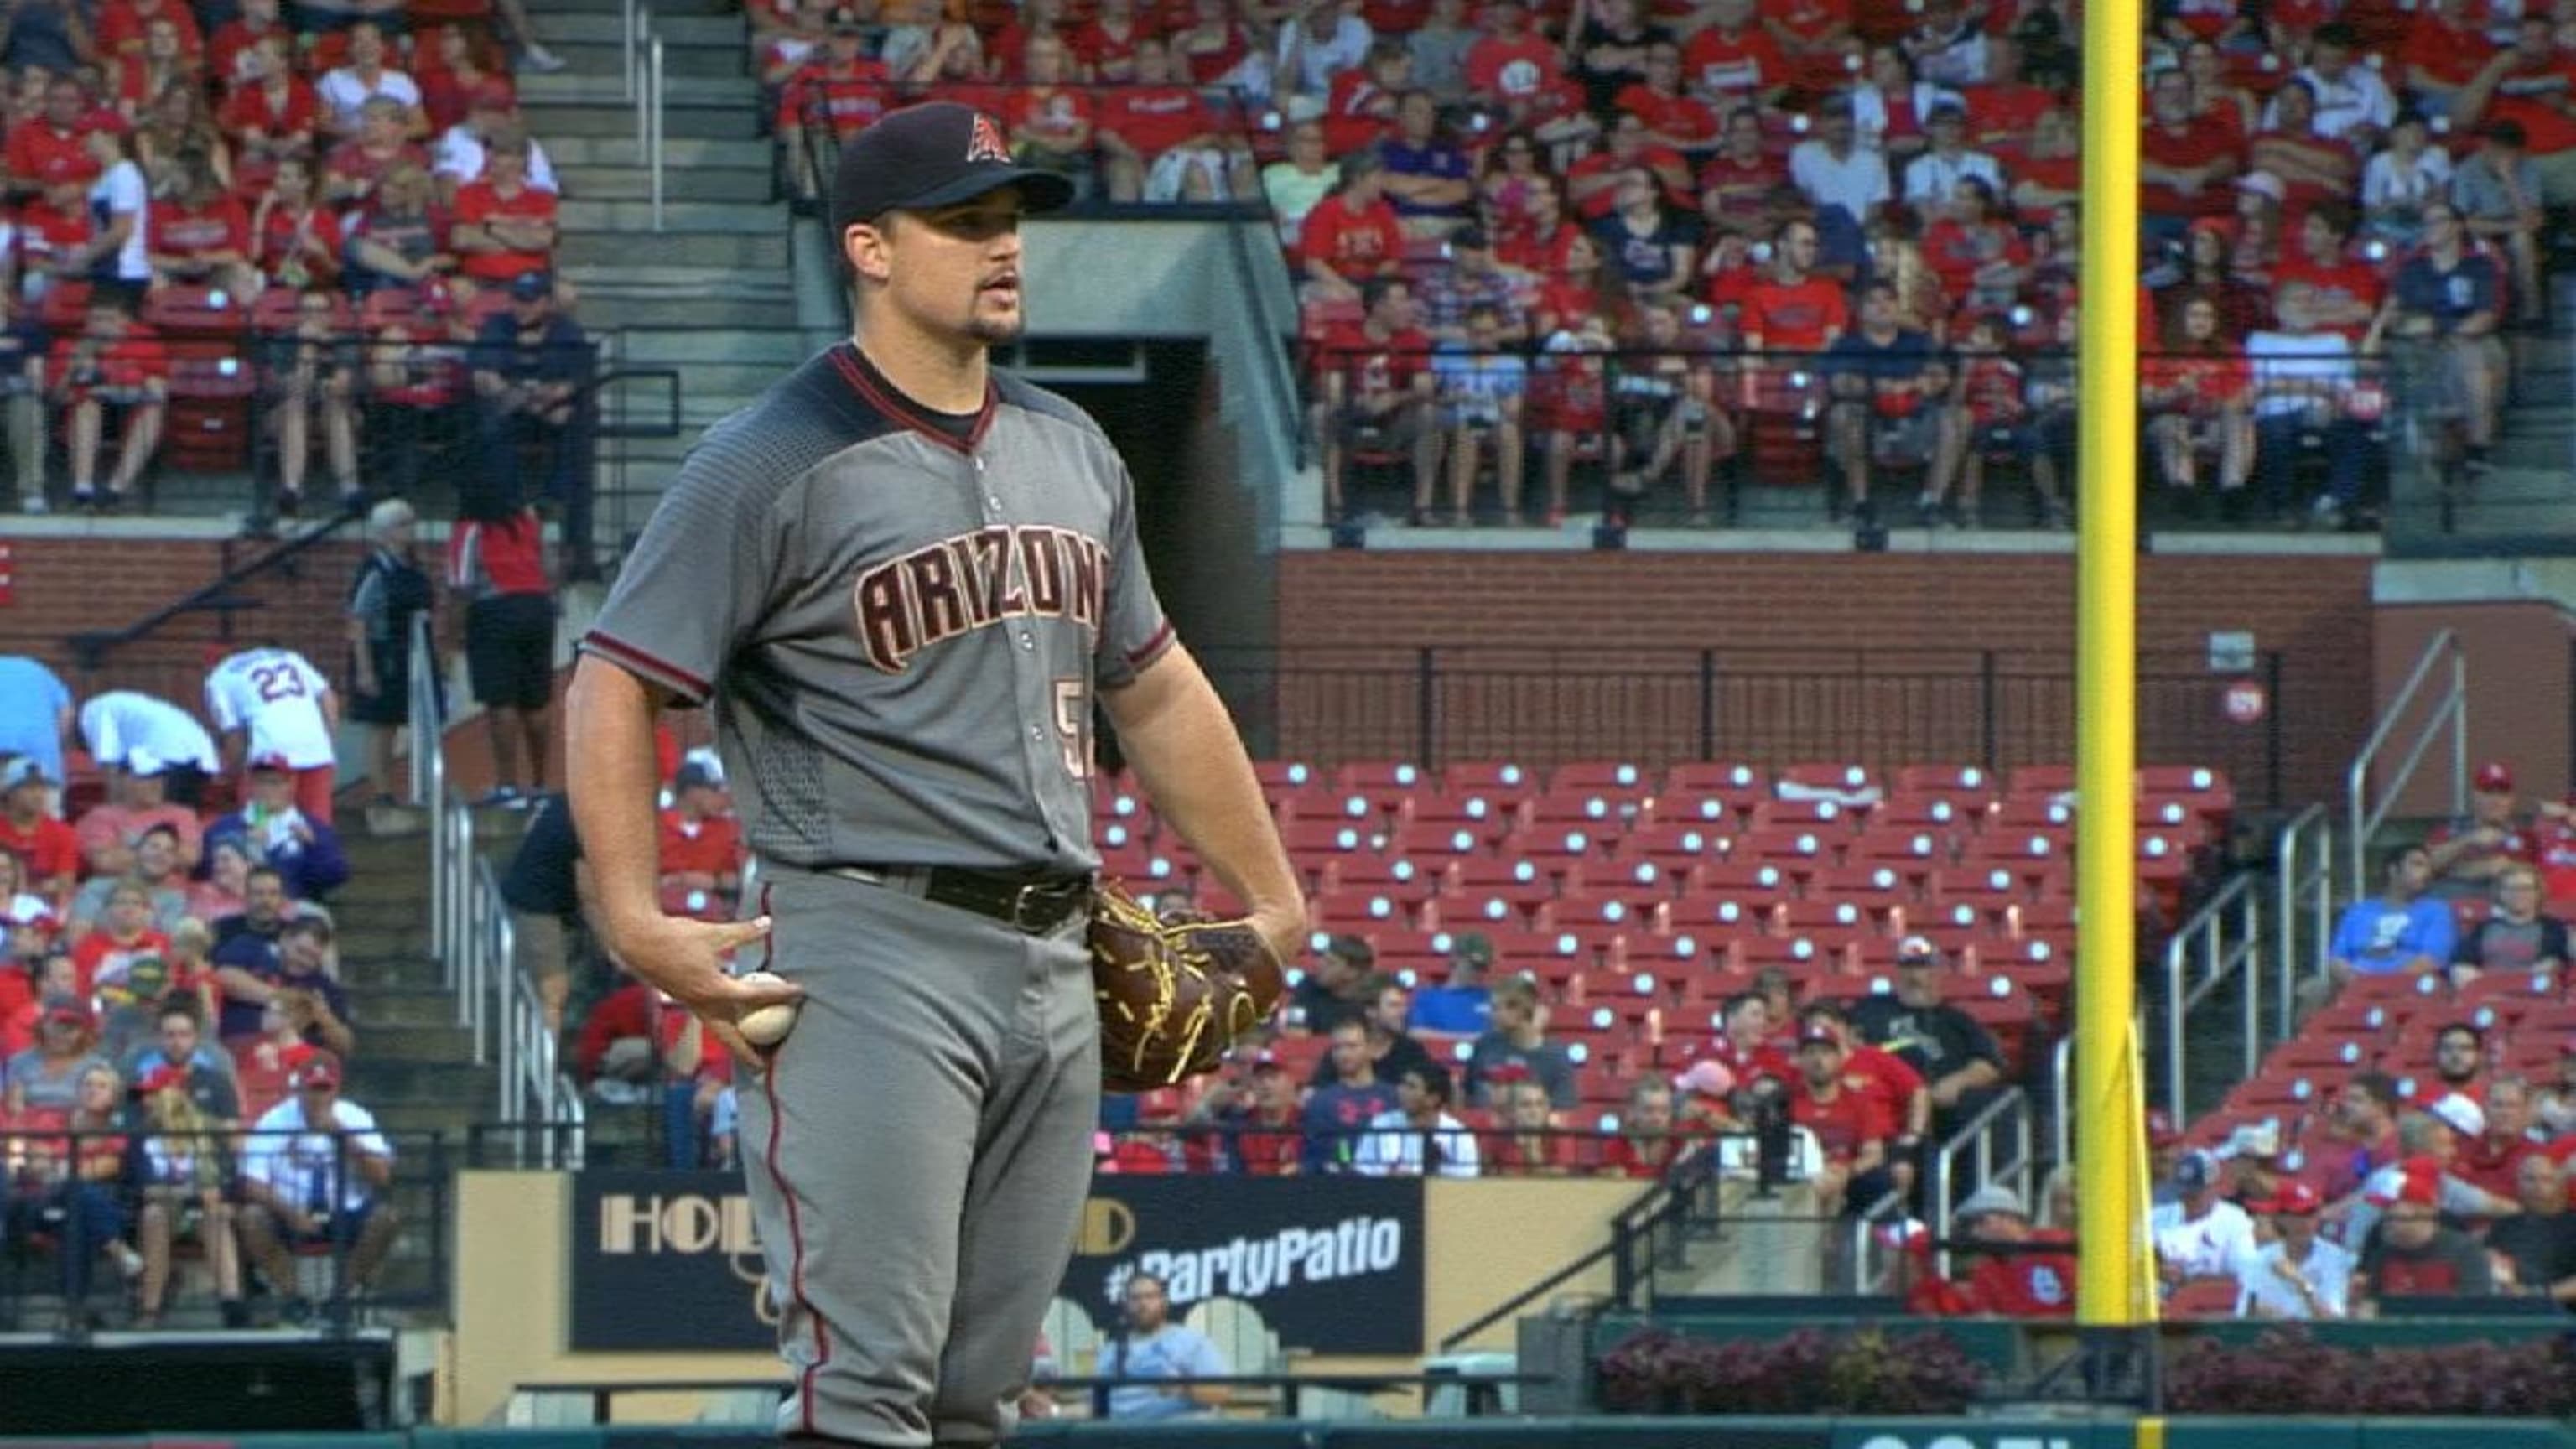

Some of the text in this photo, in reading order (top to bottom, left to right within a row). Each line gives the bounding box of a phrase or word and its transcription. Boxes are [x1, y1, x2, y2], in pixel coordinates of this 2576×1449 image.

[854, 524, 1112, 675] ARIZON
[1050, 678, 1095, 781] 5
[601, 1195, 764, 1254] HOL
